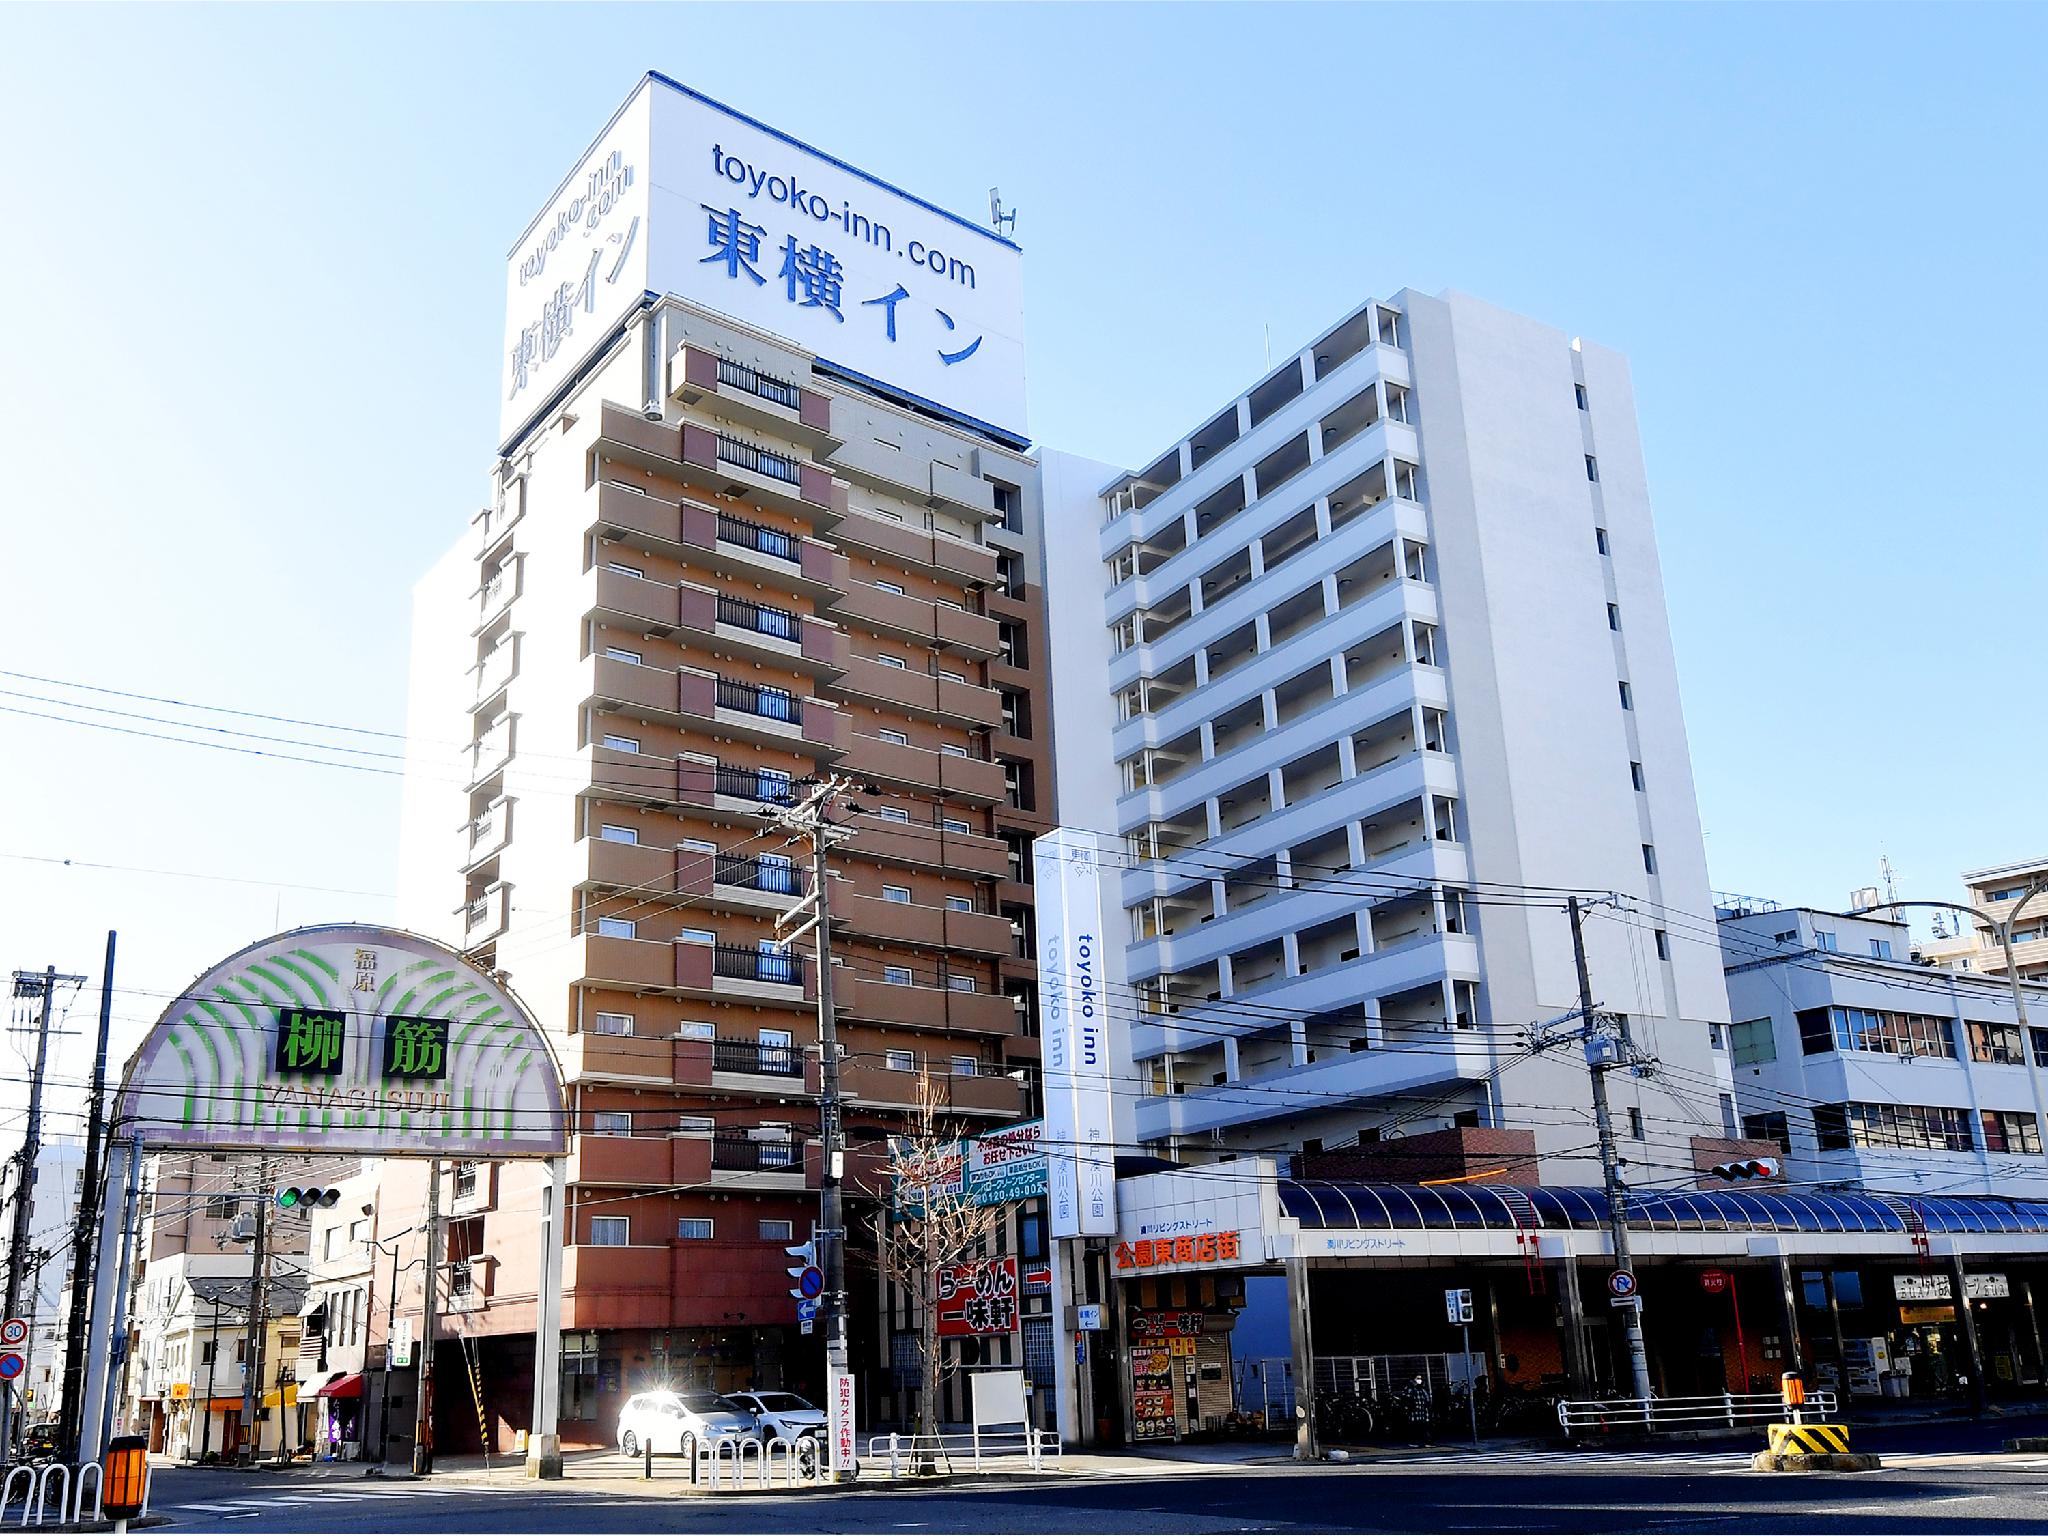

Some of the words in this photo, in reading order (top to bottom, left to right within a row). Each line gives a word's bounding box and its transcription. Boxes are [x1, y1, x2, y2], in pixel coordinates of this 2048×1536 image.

[519, 150, 622, 287] toyoko-inn
[582, 164, 634, 238] .com
[711, 142, 977, 289] toyoko-inn.com
[698, 202, 983, 365] 東横イン
[508, 215, 640, 402] 東横イン
[353, 947, 378, 993] 福原
[1047, 934, 1063, 1021] toyoko
[1077, 933, 1094, 1019] toyoko
[1051, 1027, 1064, 1068] inn
[1083, 1025, 1098, 1066] inn
[262, 1083, 377, 1112] YANAGI
[386, 1088, 451, 1115] SUJI
[1114, 1230, 1241, 1269] 公園東商店街
[938, 1261, 1015, 1300] らーめん
[6, 1325, 22, 1338] 30
[941, 1295, 1015, 1332] 一味軒
